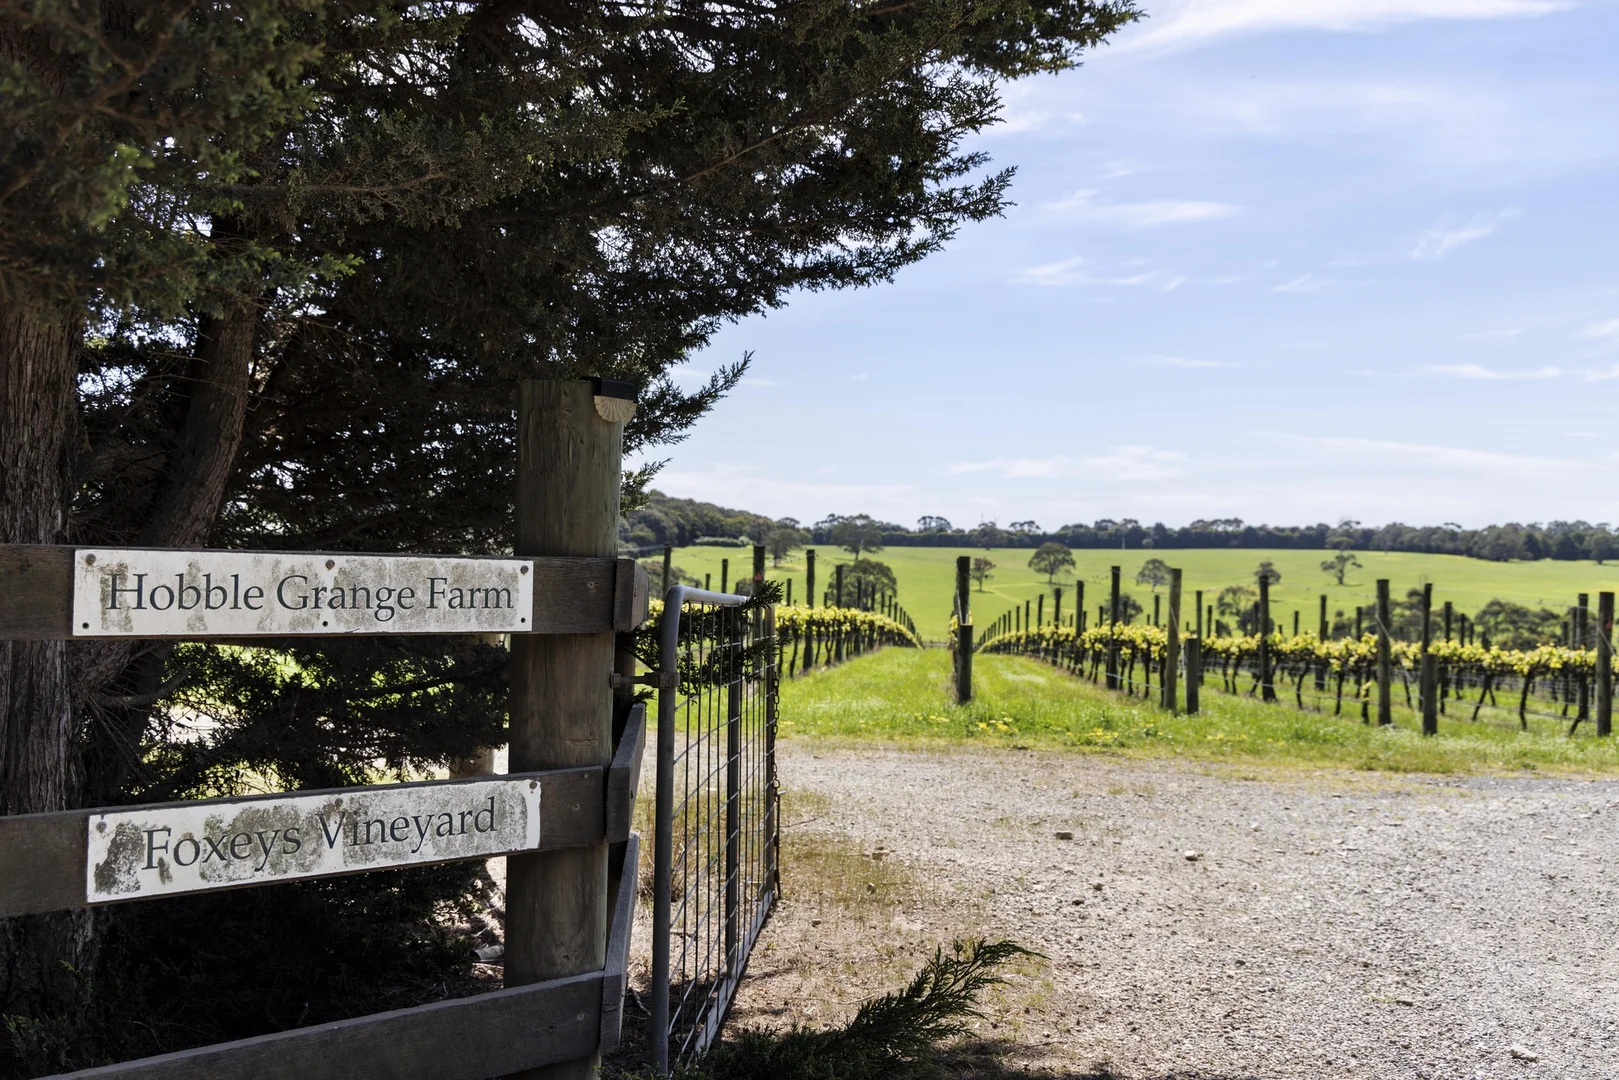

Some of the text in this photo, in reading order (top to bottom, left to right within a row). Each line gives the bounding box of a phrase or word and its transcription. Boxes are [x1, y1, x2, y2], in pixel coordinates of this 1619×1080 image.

[107, 572, 514, 622] Hobble Grange Farm
[141, 796, 497, 872] Foxeys Vineyard
